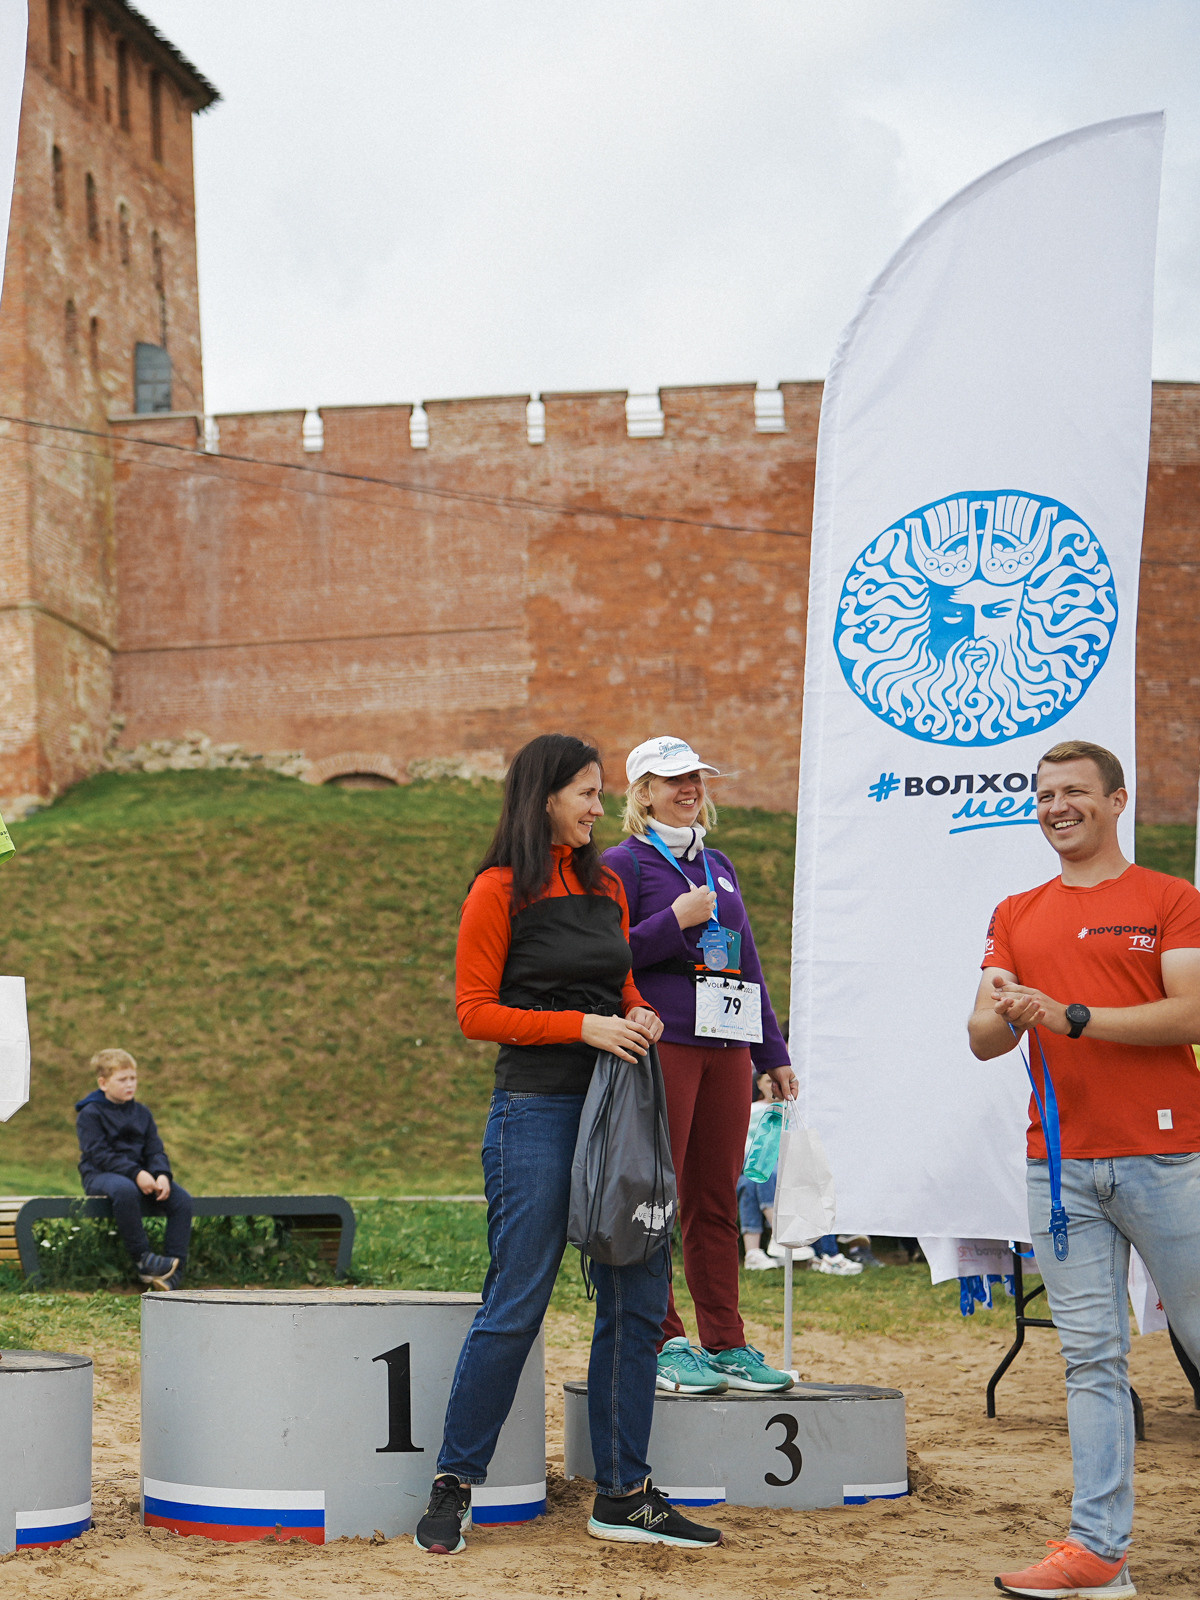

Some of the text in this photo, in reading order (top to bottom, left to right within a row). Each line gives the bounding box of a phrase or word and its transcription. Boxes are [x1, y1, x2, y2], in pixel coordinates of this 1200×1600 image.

[867, 772, 1038, 802] #ВОЛХО
[1077, 924, 1157, 940] #novgorod
[1128, 935, 1156, 949] TRI
[723, 996, 742, 1015] 79
[371, 1342, 425, 1453] 1
[764, 1413, 803, 1487] 3
